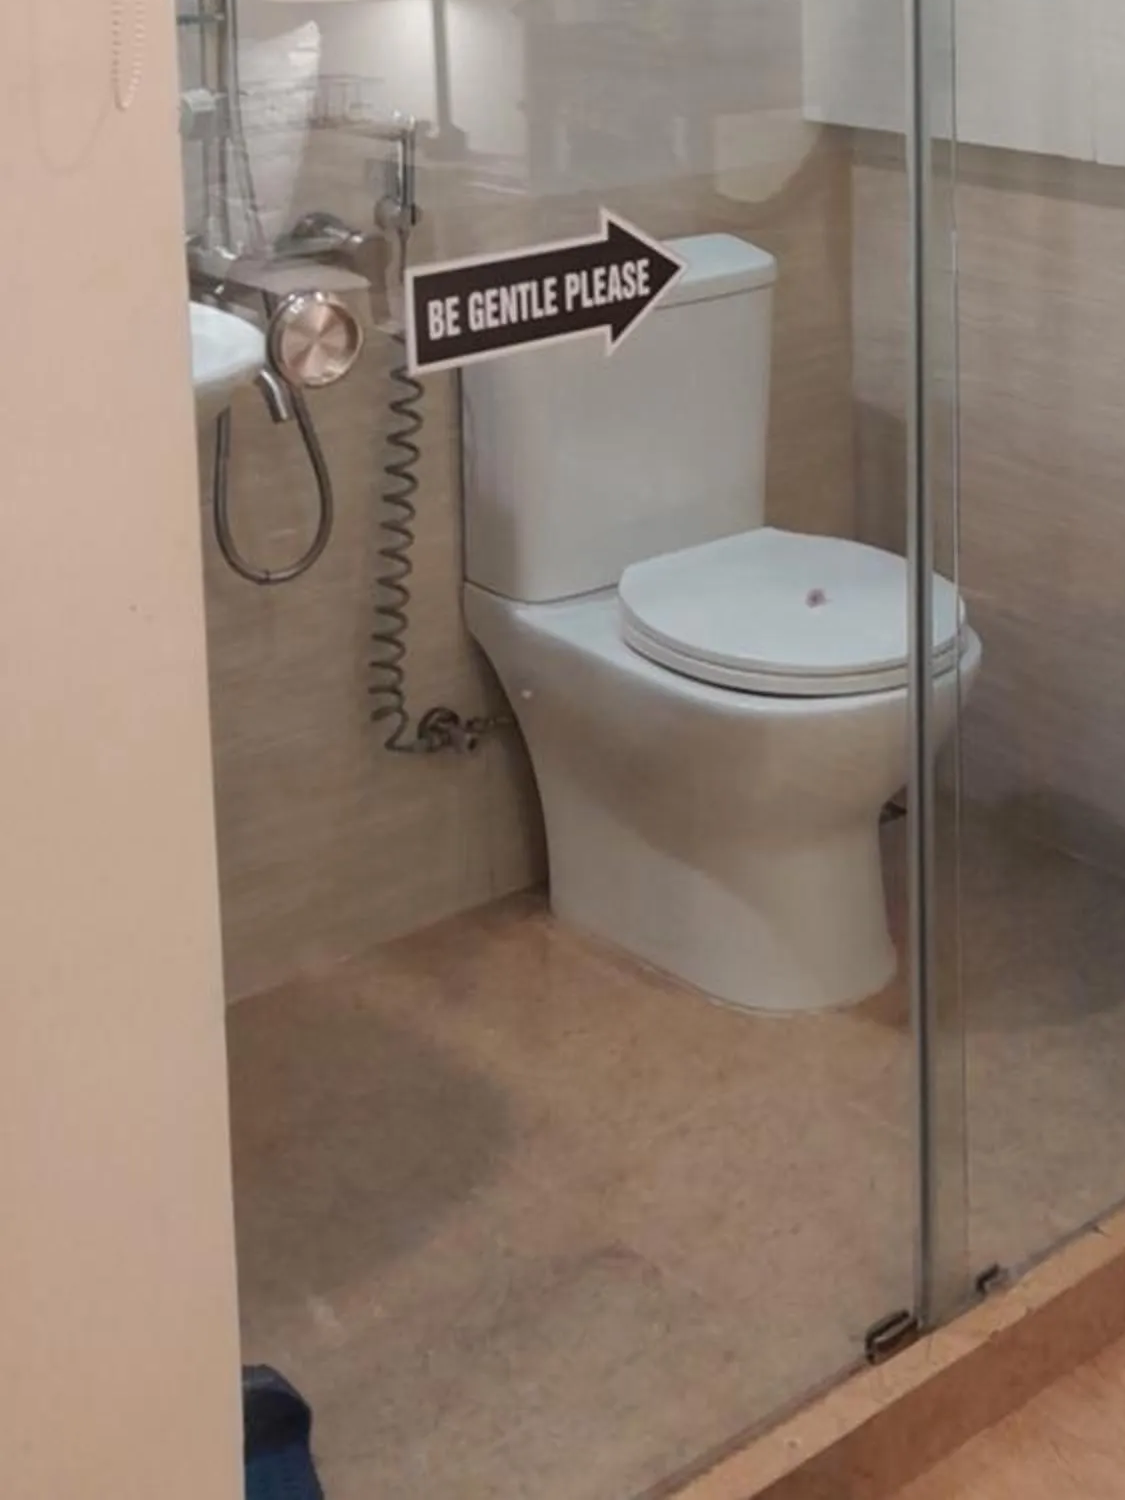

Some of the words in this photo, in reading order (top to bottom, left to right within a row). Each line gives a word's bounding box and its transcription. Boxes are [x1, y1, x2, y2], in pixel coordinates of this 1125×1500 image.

[427, 297, 461, 341] BE
[467, 277, 558, 332] GENTLE
[564, 257, 651, 312] PLEASE
